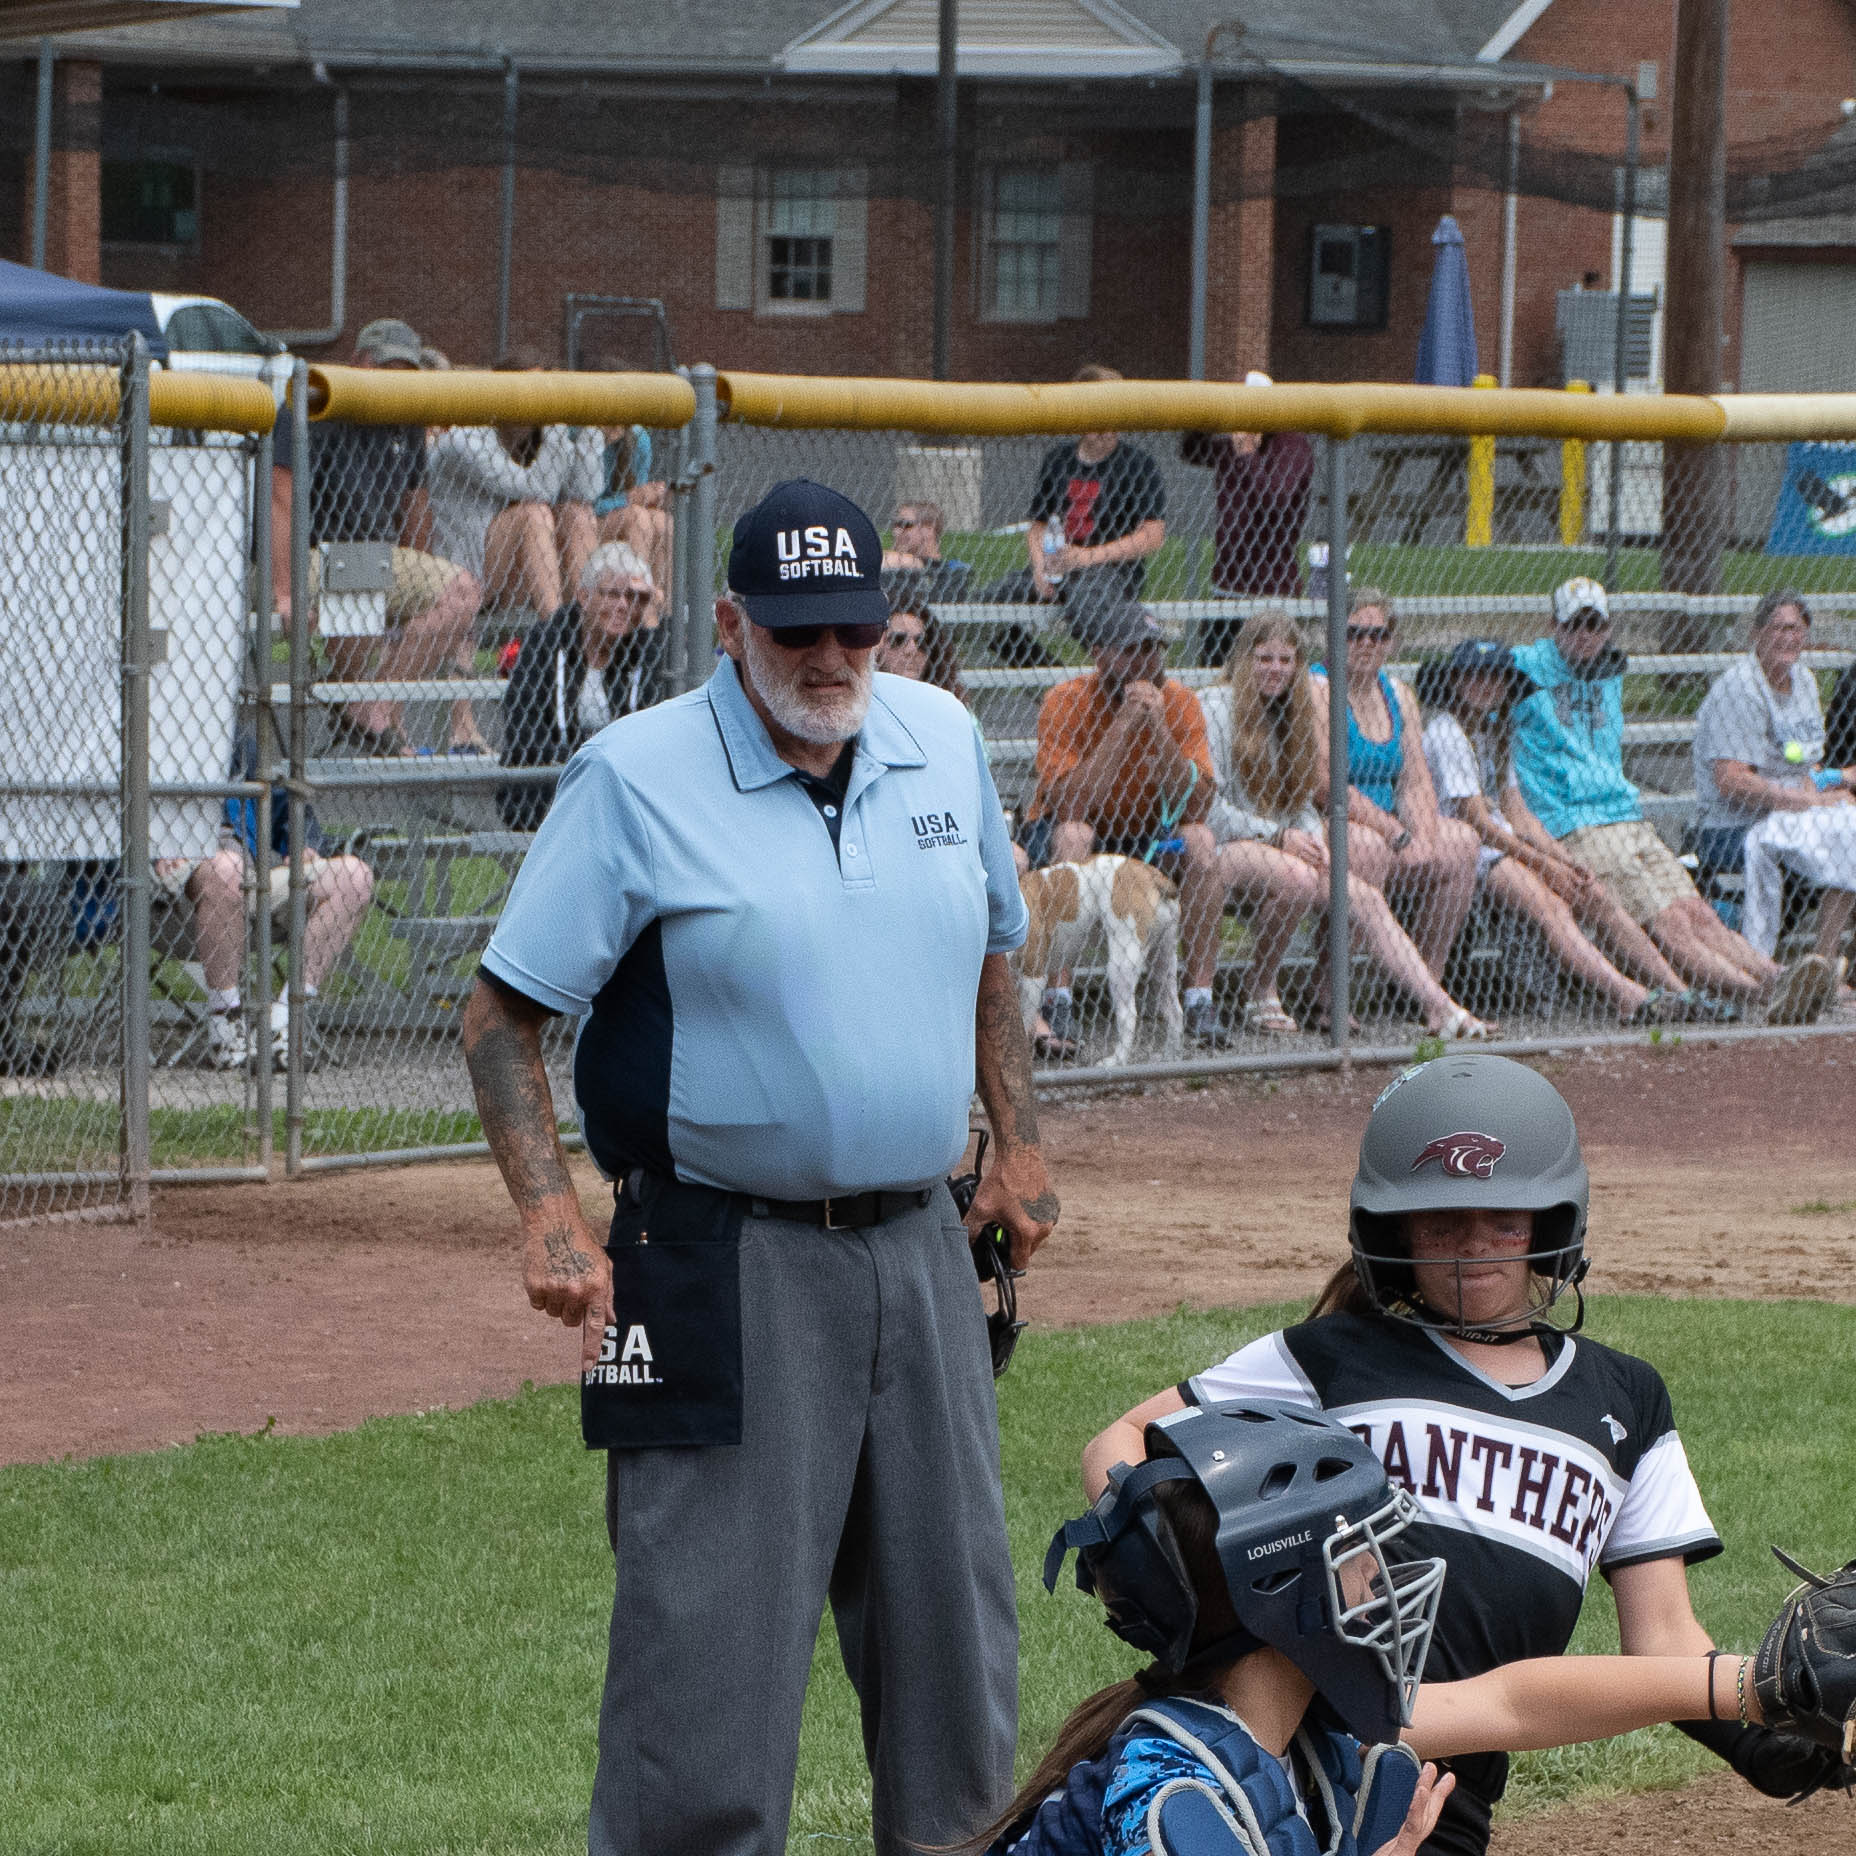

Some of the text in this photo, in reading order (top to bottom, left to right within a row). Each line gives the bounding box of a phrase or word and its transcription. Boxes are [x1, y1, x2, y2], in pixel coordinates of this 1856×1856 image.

[777, 526, 857, 561] USA
[779, 559, 859, 580] SOFTBALL
[911, 811, 959, 837] USA
[918, 834, 964, 850] SOFTBALL
[597, 1325, 654, 1362] SA
[1247, 1529, 1313, 1561] LOUISVILLE
